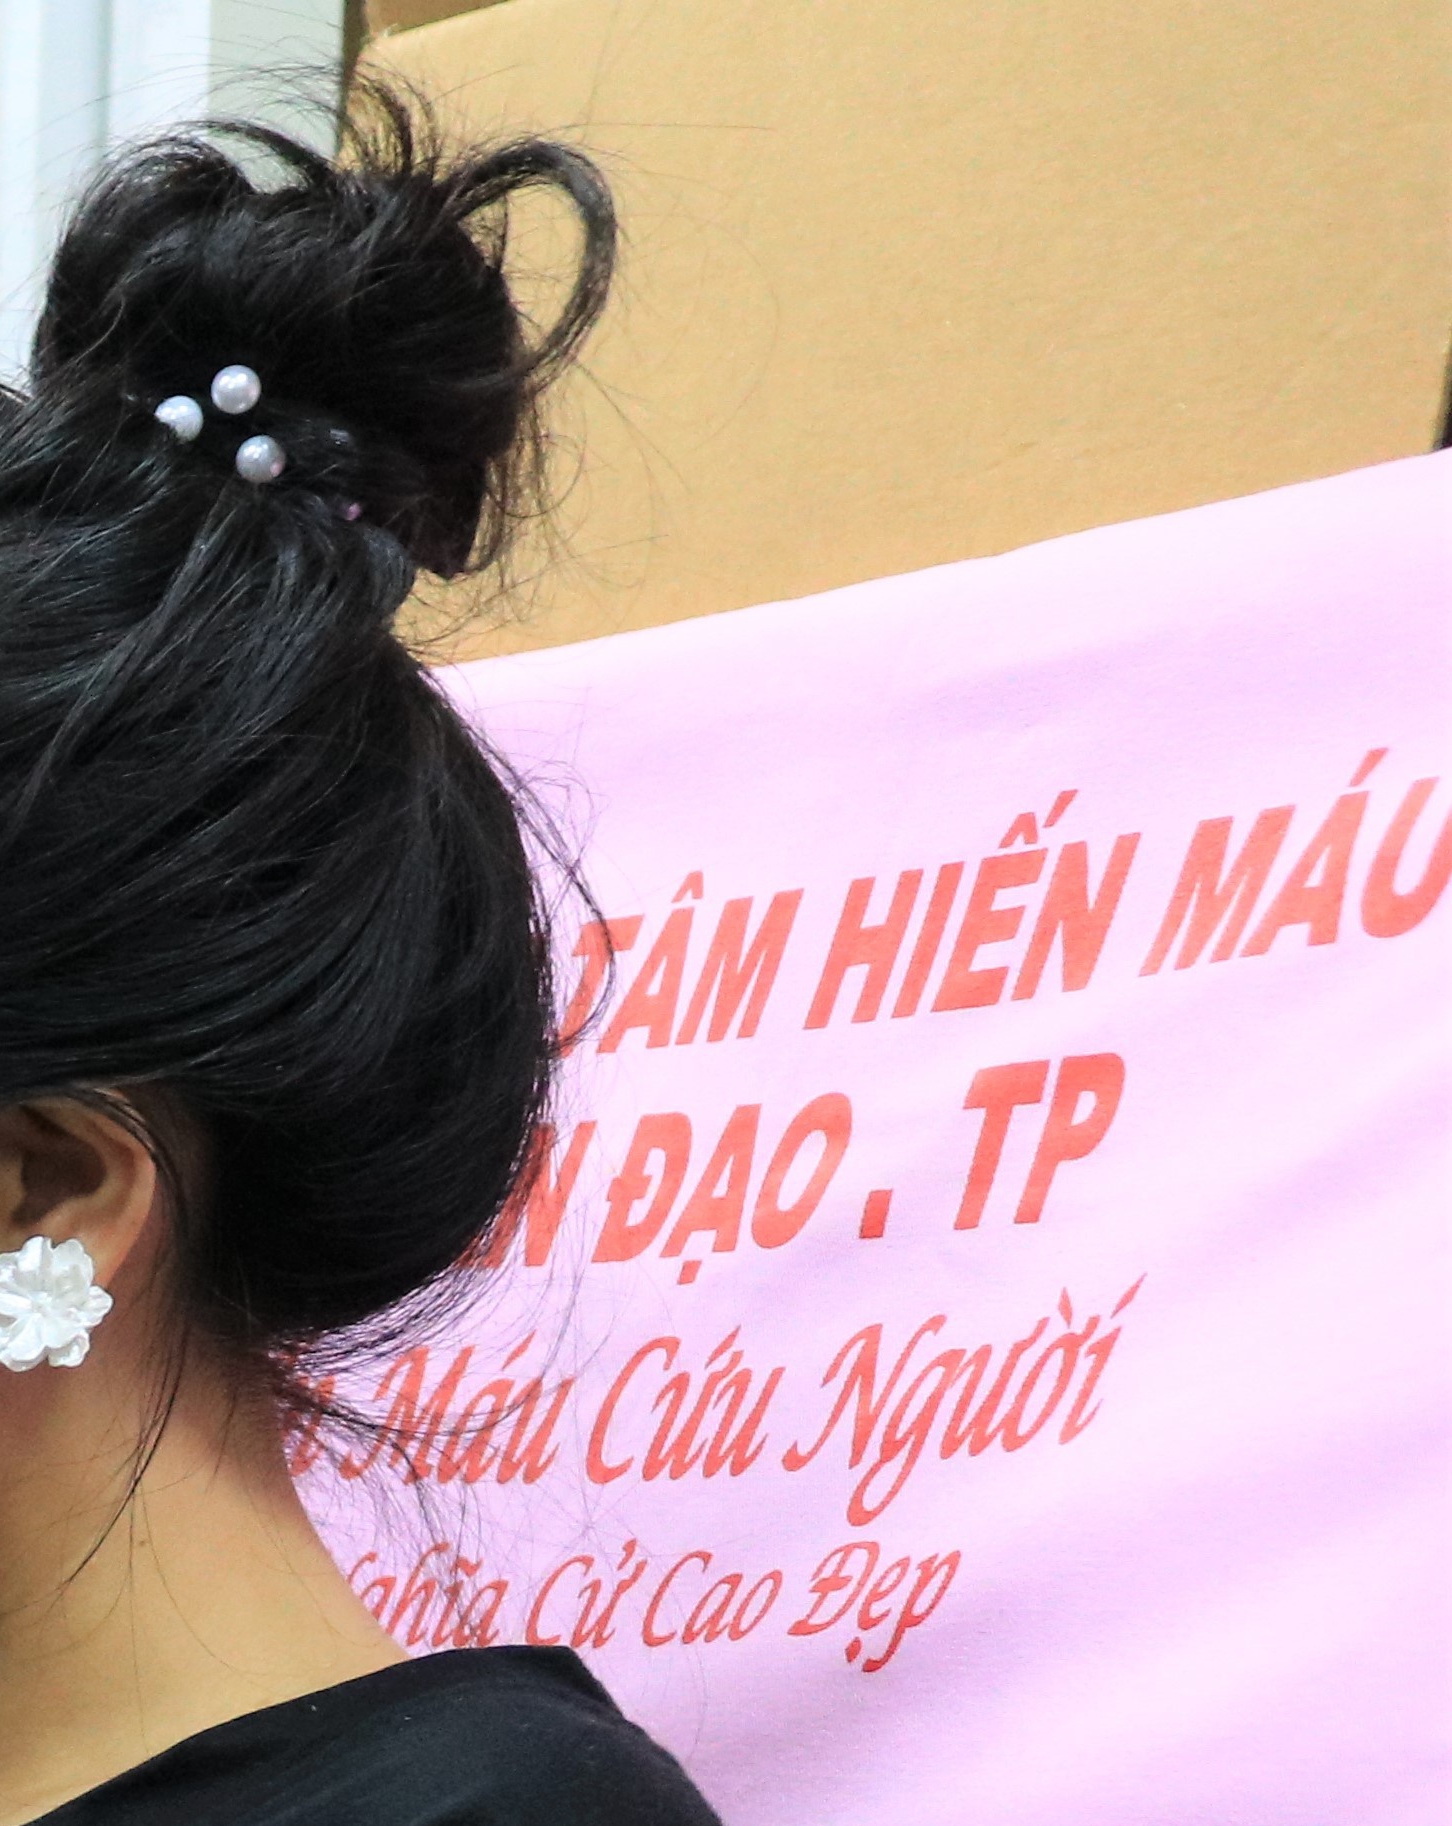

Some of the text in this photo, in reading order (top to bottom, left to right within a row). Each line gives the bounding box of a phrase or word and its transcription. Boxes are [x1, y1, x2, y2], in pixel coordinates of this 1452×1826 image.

[556, 747, 1452, 1060] TÂM HIẾN MÁU
[590, 1092, 853, 1286] ĐẠO
[953, 1052, 1126, 1231] TP
[338, 1330, 576, 1485] Máu
[586, 1325, 785, 1485] Cứu
[782, 1273, 1147, 1527] Người
[524, 1539, 648, 1647] Cử
[643, 1550, 783, 1647] Cao
[787, 1541, 962, 1673] Đẹp
